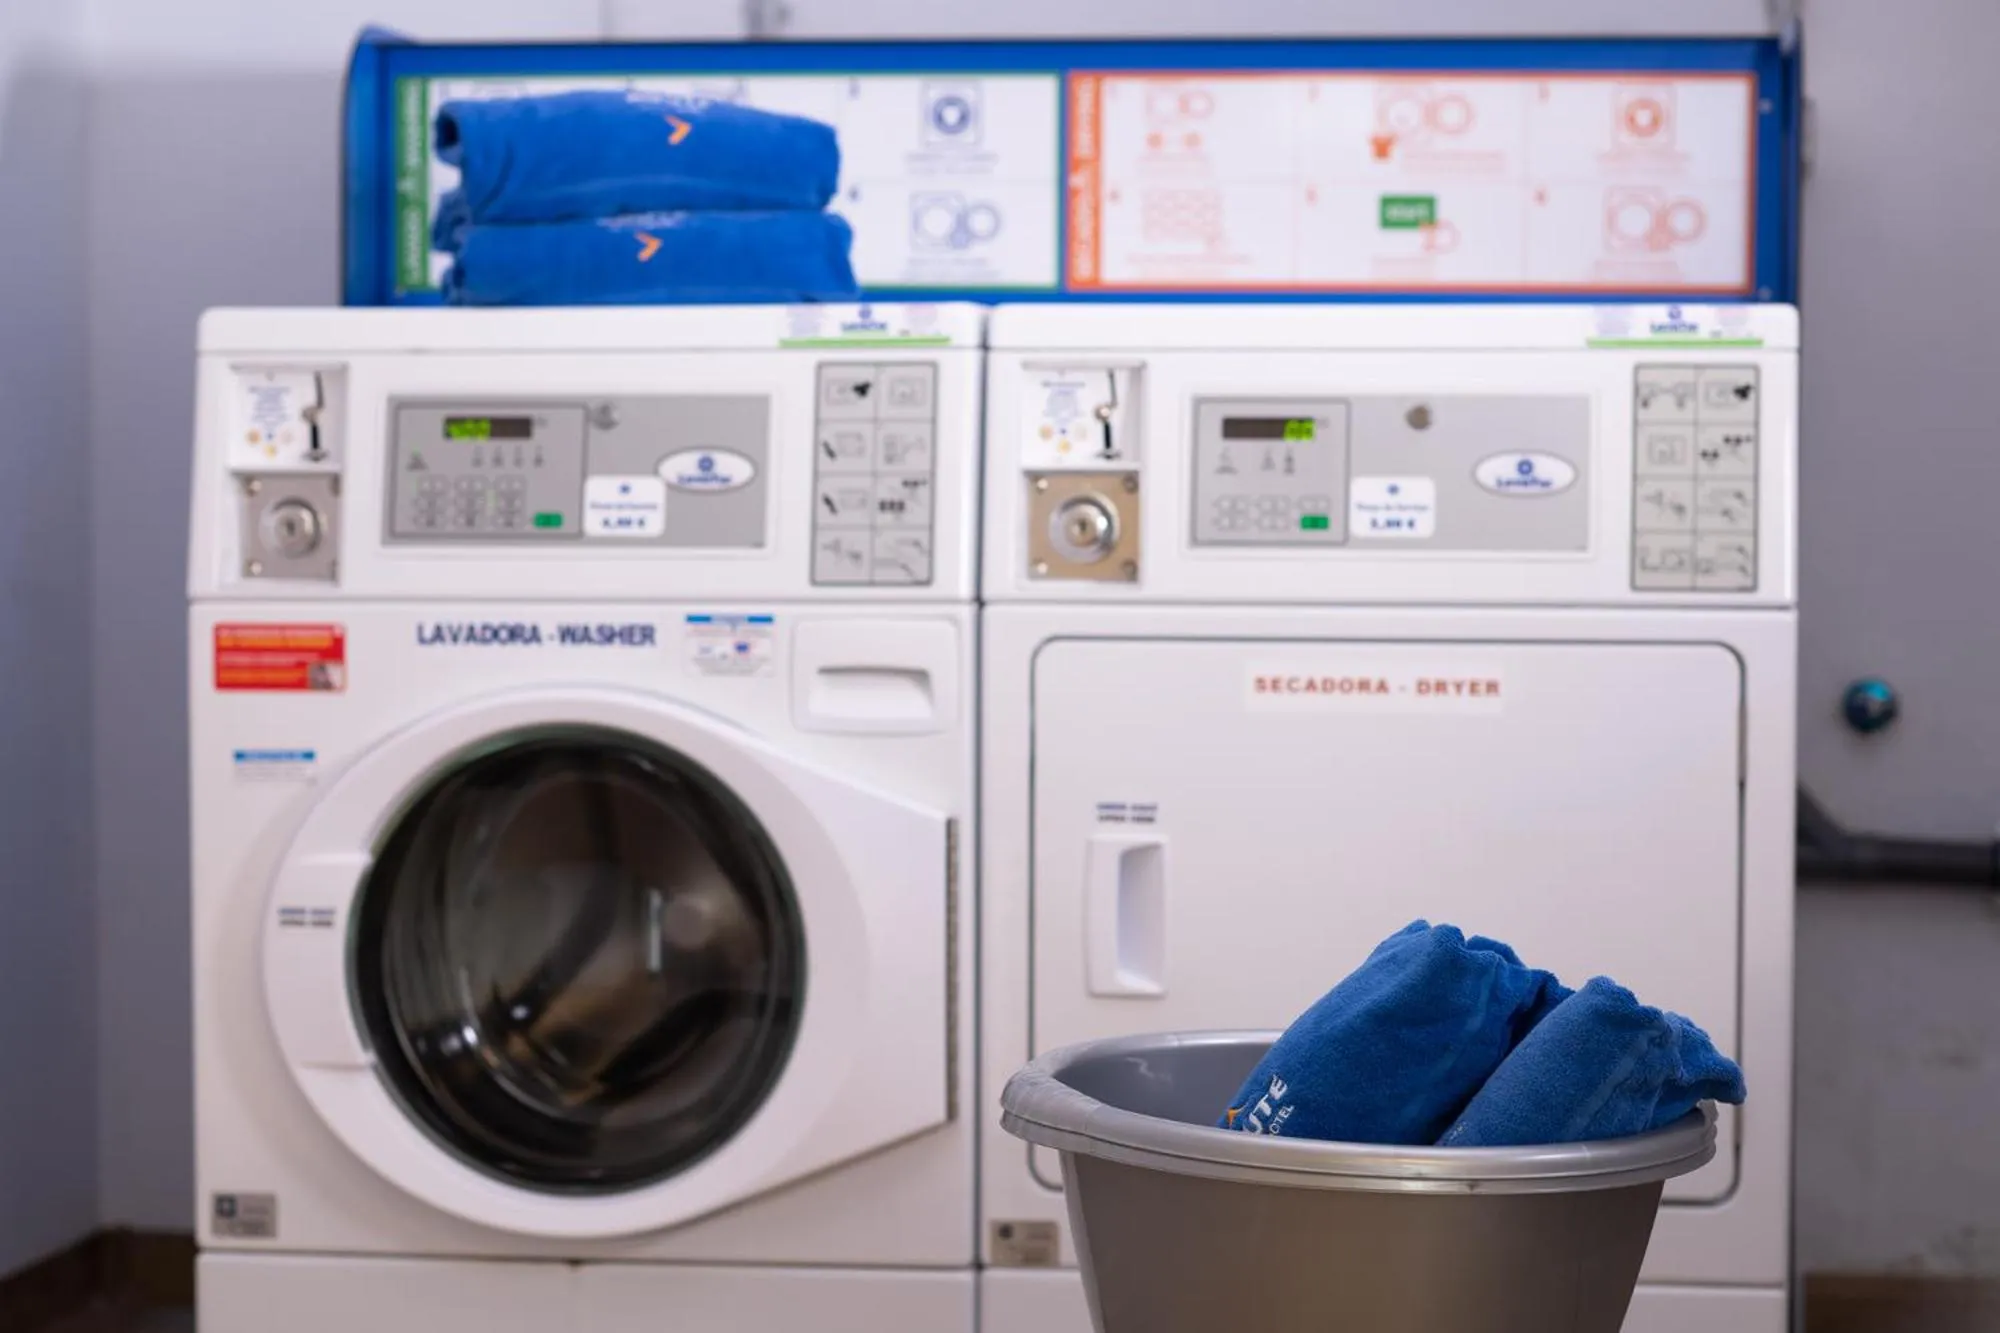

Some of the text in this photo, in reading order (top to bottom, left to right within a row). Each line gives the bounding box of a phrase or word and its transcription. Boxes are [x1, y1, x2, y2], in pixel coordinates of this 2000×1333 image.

[416, 622, 542, 646] LAVADORA
[557, 623, 656, 647] WASHER
[1254, 677, 1389, 694] SECADORA
[1416, 678, 1500, 697] DRYER
